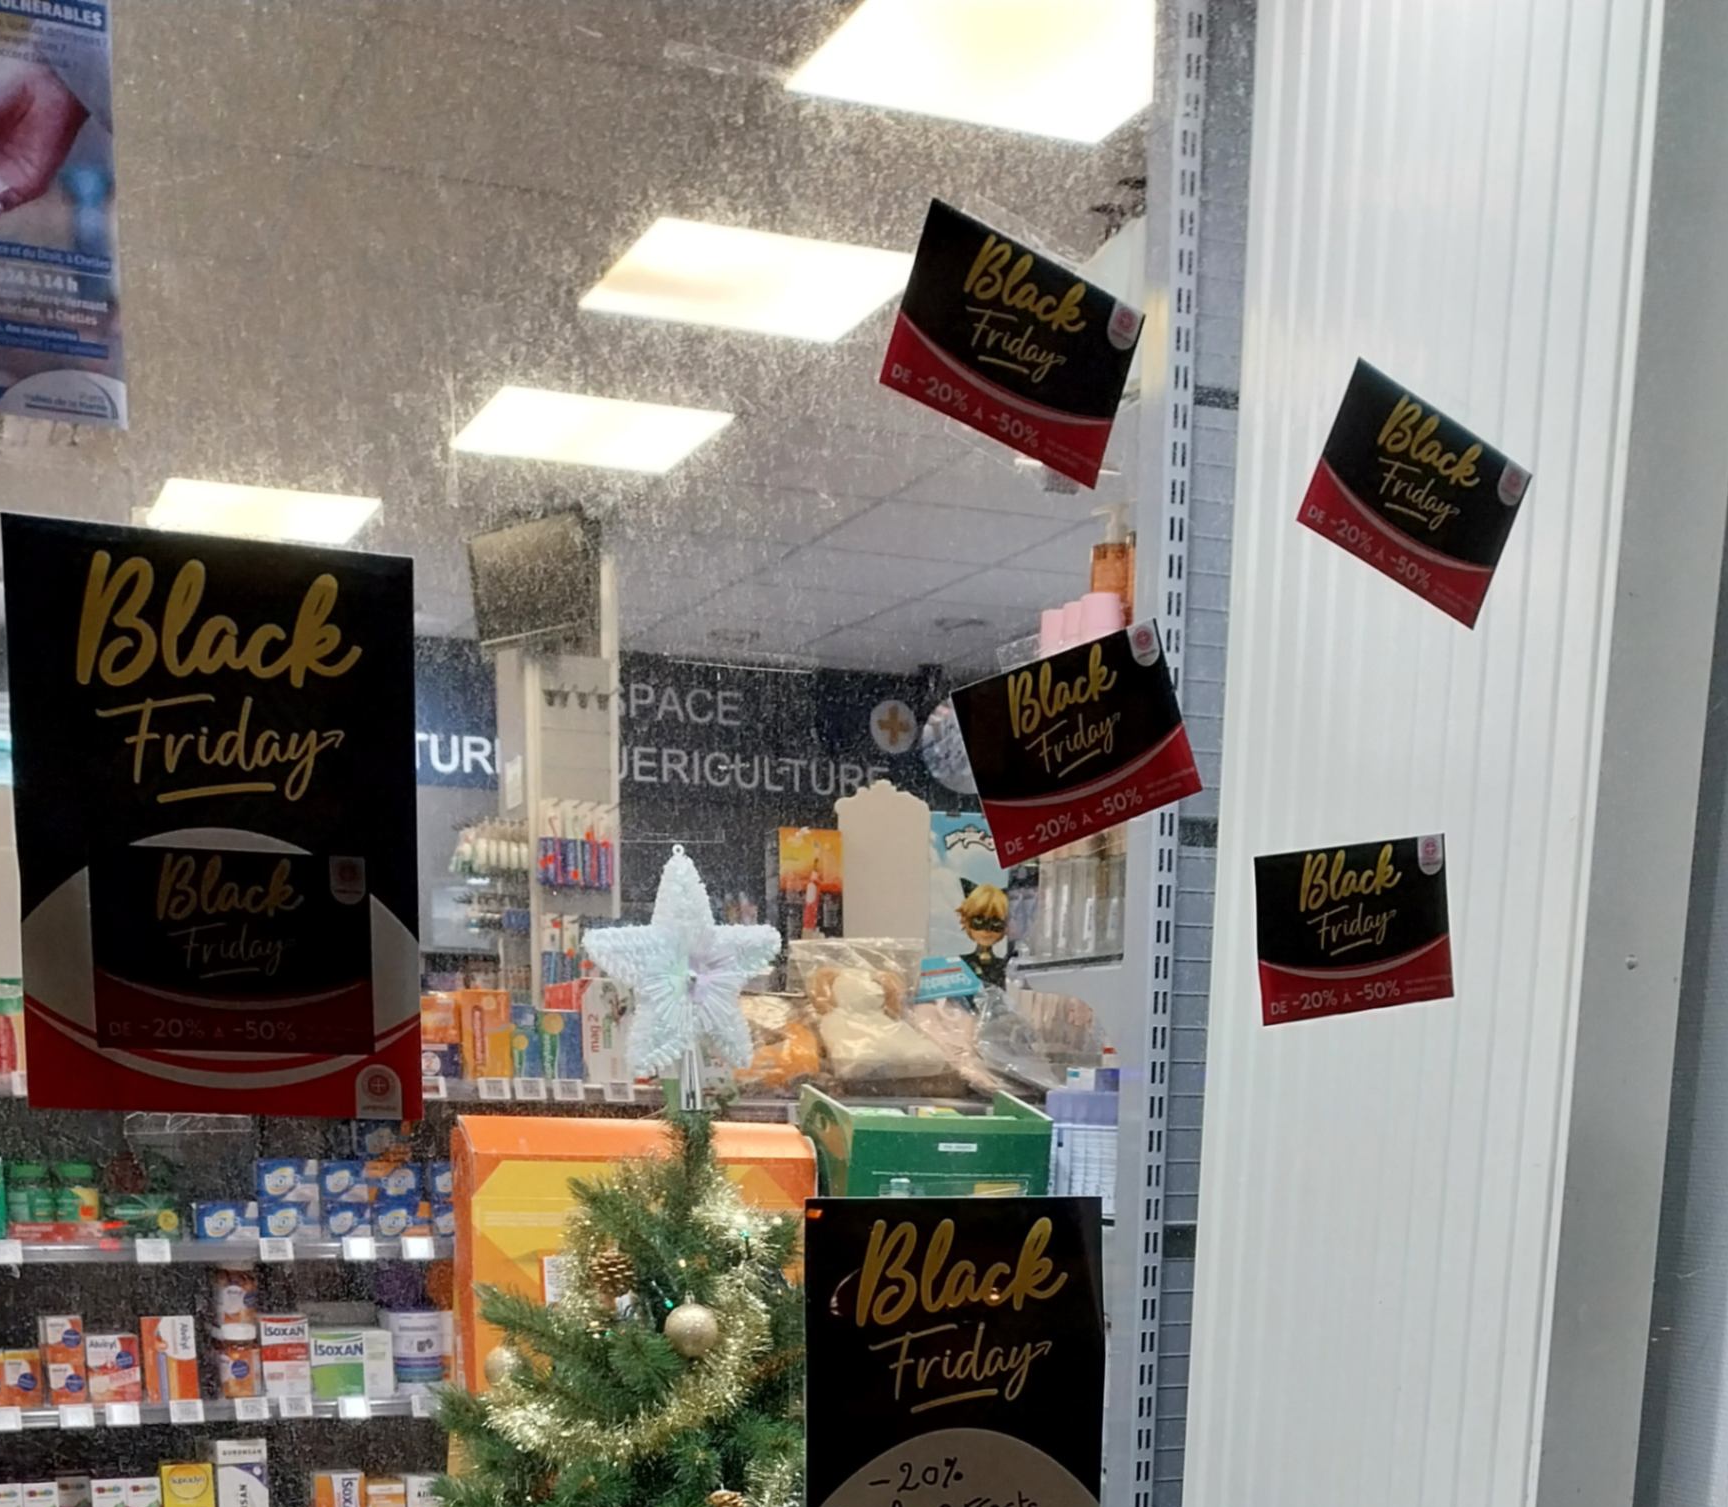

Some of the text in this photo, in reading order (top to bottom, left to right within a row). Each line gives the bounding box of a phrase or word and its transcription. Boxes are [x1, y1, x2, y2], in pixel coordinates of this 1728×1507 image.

[44, 274, 64, 289] 14
[67, 276, 79, 292] h
[963, 234, 1087, 333] Black
[965, 304, 1067, 383] Friday
[891, 363, 911, 384] DE
[917, 375, 968, 413] -20%
[989, 412, 1041, 449] -50%
[1377, 394, 1483, 488] Black
[1378, 456, 1460, 531] Friday
[1307, 503, 1326, 524] DE
[1329, 518, 1373, 552] -20%
[1389, 553, 1433, 590] -50%
[76, 550, 363, 688] Black
[1008, 643, 1118, 739] Black
[95, 693, 345, 801] Friday
[1025, 712, 1121, 774] Friday
[1004, 837, 1025, 856] DE
[1027, 812, 1078, 843] -20%
[1095, 786, 1143, 817] -50%
[155, 852, 304, 921] Black
[1299, 843, 1403, 912] Black
[167, 922, 296, 975] Friday
[1306, 902, 1397, 950] Friday
[109, 1021, 132, 1038] DE
[139, 1018, 205, 1041] -20%
[233, 1019, 298, 1042] -50%
[1271, 1001, 1288, 1015] DE
[1292, 989, 1338, 1011] -20%
[1356, 979, 1401, 1000] -50%
[856, 1216, 1068, 1327] Black
[264, 1322, 305, 1338] ISOXAN
[314, 1339, 364, 1356] ISOXAN
[868, 1322, 1053, 1401] Friday
[868, 1457, 964, 1493] -20%
